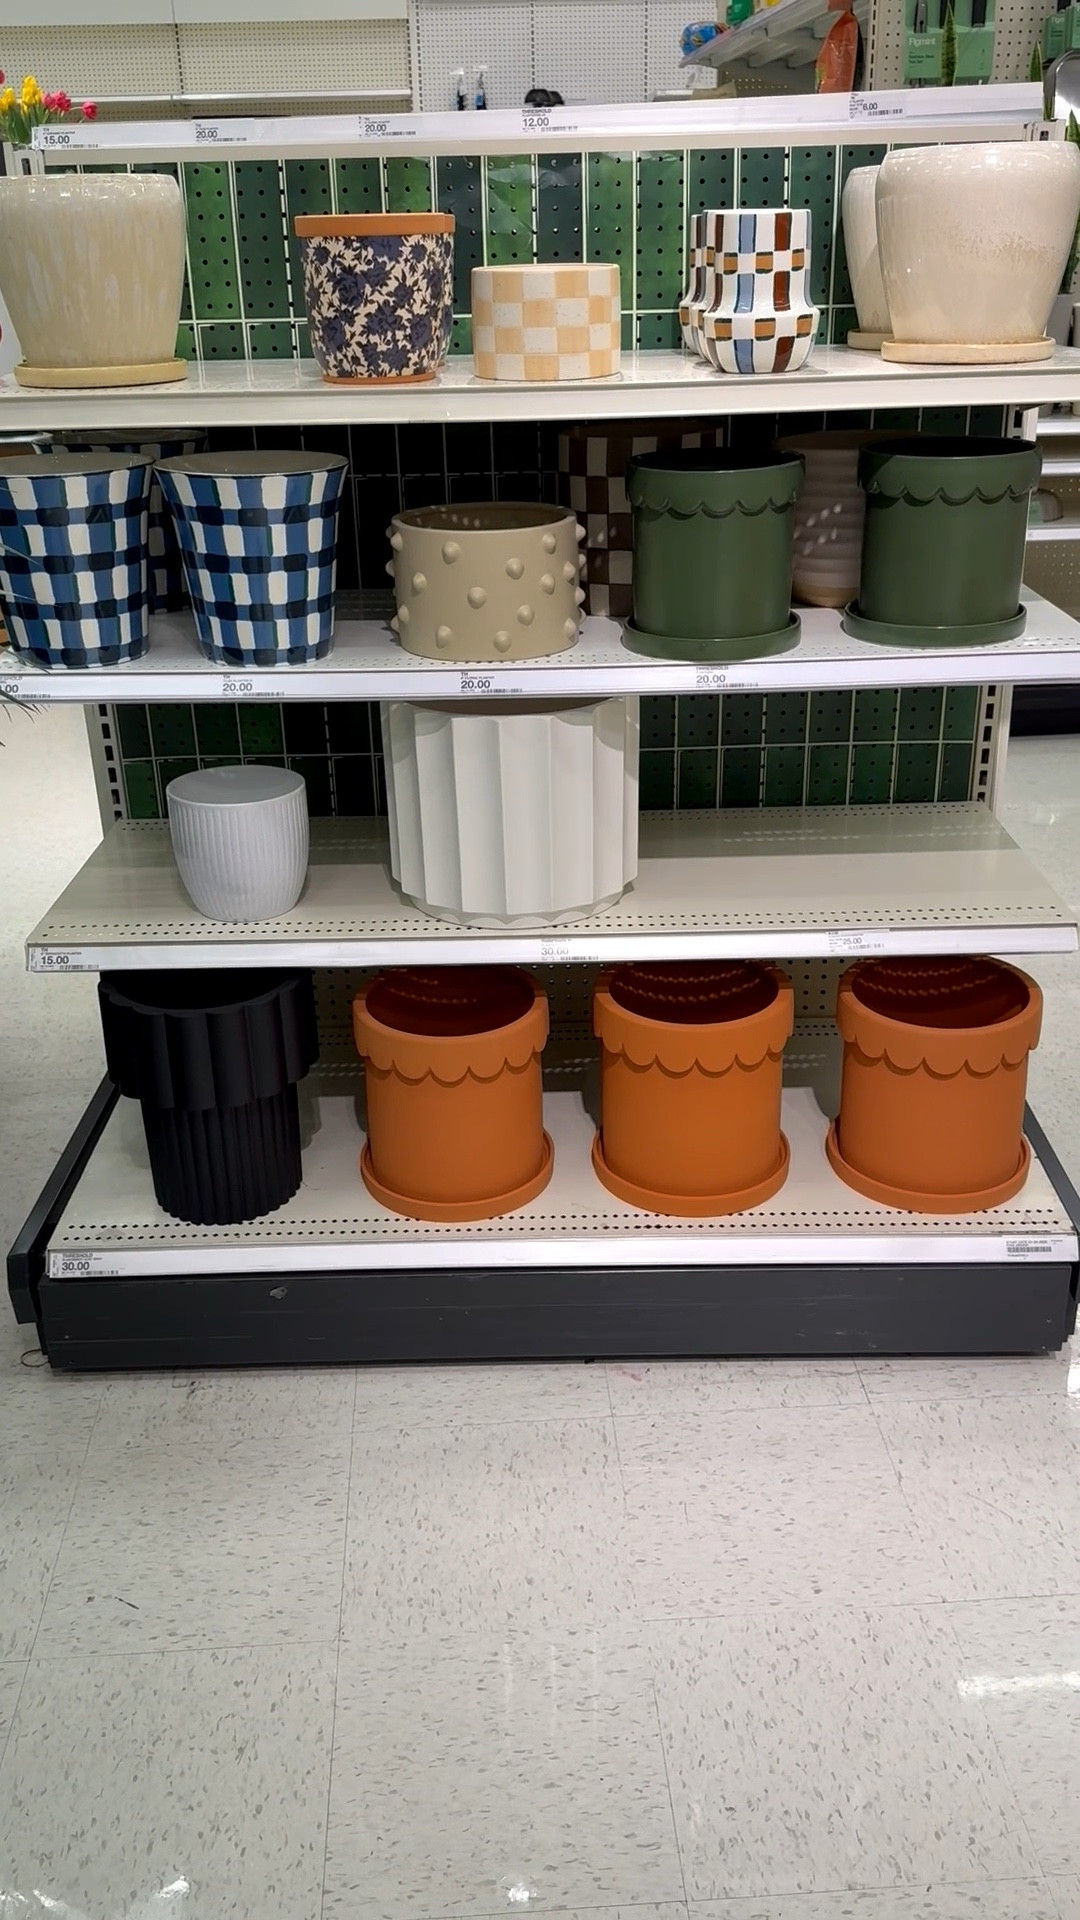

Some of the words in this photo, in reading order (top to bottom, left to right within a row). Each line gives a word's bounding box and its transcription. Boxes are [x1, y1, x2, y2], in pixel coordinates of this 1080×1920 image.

[909, 38, 936, 47] Figmint
[862, 102, 878, 111] 6.00
[522, 117, 549, 127] 12.00
[365, 123, 387, 132] 20.00
[196, 130, 218, 139] 20.00
[44, 135, 70, 145] 15.00
[696, 674, 726, 684] 20.00
[222, 682, 253, 692] 20.00
[460, 680, 491, 689] 20.00
[842, 937, 863, 946] 25.00
[541, 947, 569, 956] 30.00
[41, 956, 70, 965] 15.00
[61, 1261, 90, 1271] 30.00
